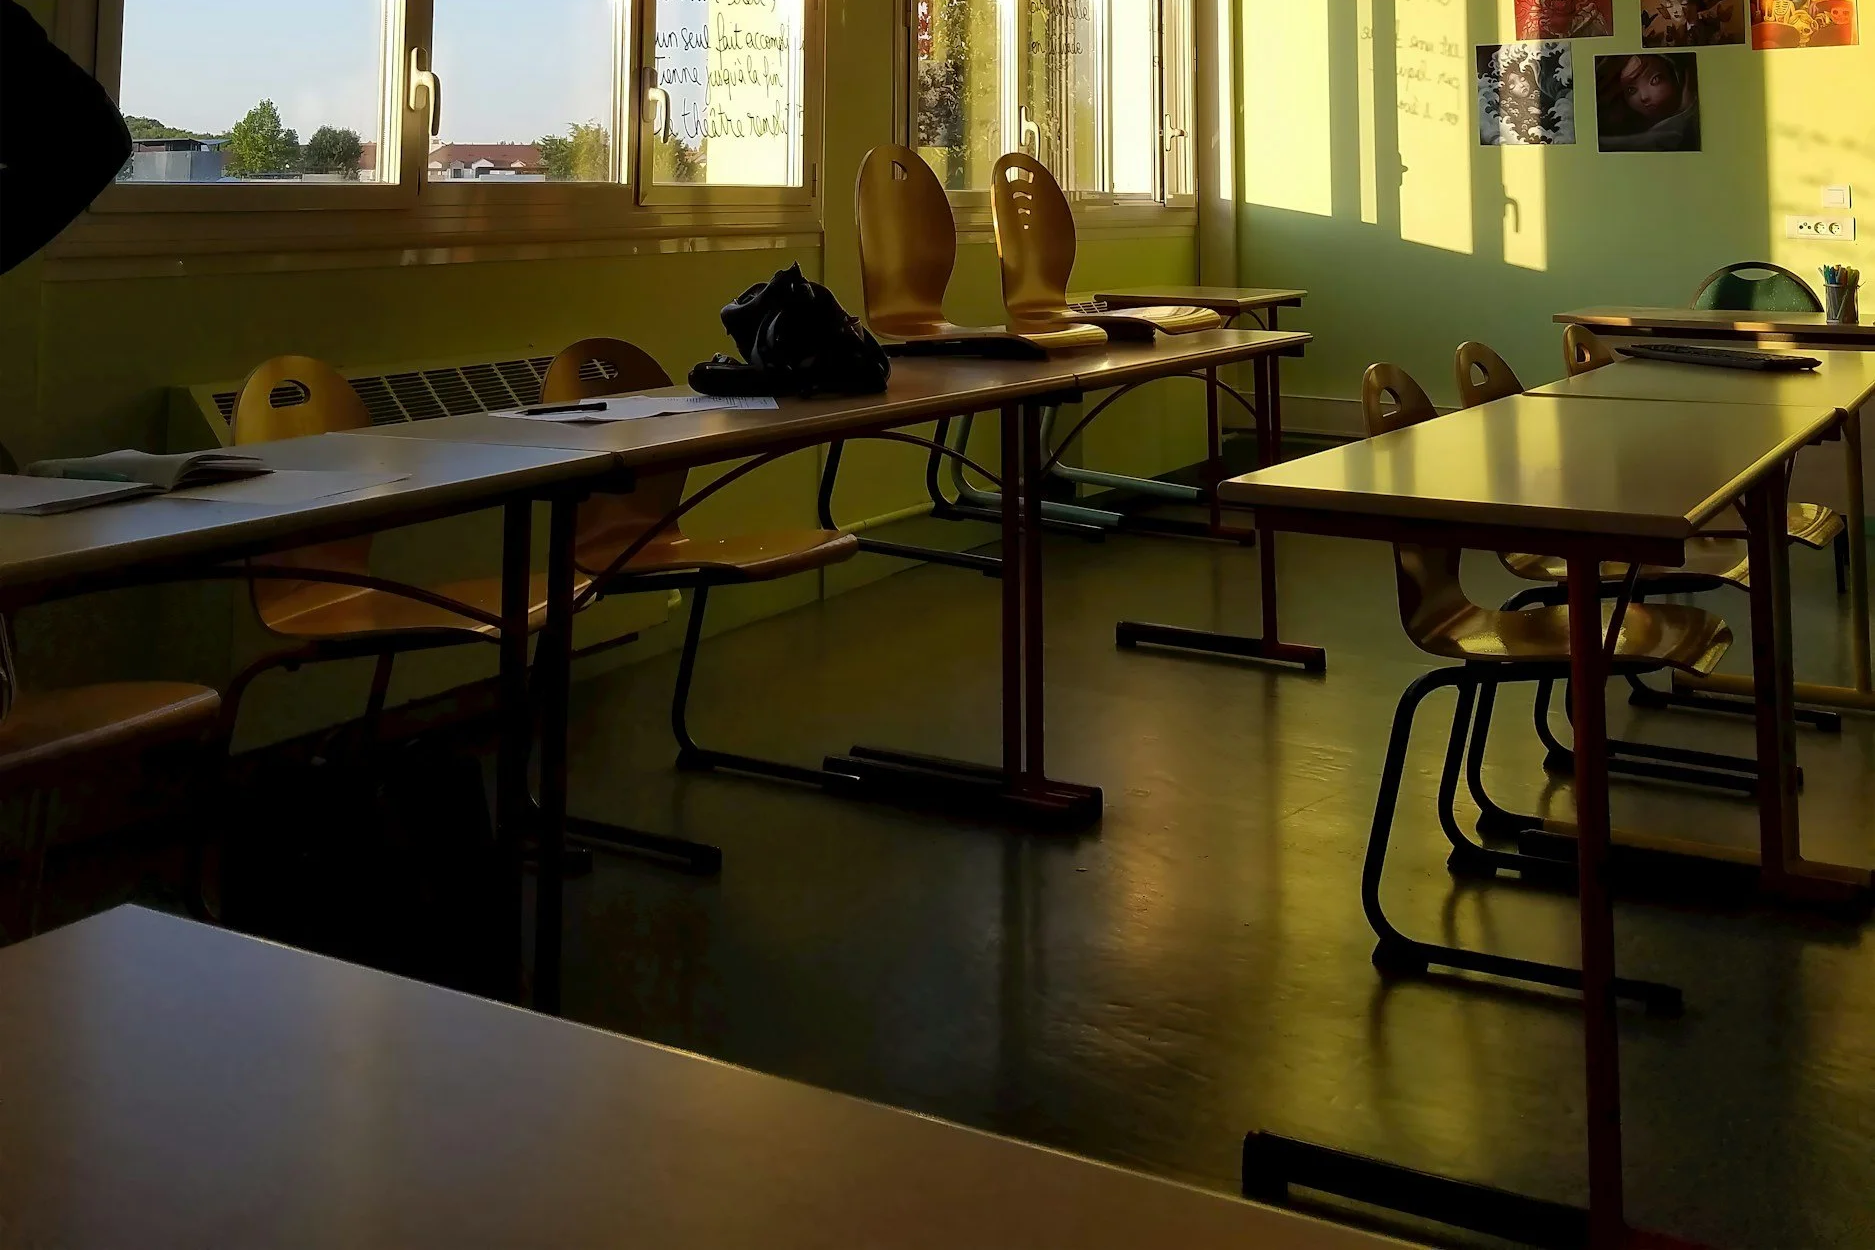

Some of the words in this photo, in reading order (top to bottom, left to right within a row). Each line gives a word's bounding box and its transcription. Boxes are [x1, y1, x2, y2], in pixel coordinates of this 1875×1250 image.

[655, 31, 678, 48] un
[681, 24, 711, 50] seul
[716, 12, 743, 70] fait
[746, 23, 789, 66] accompli
[706, 57, 746, 105] jusqu'à
[747, 54, 761, 86] la
[763, 56, 783, 98] fin
[682, 98, 744, 138] théâtre
[747, 100, 788, 138] rempli
